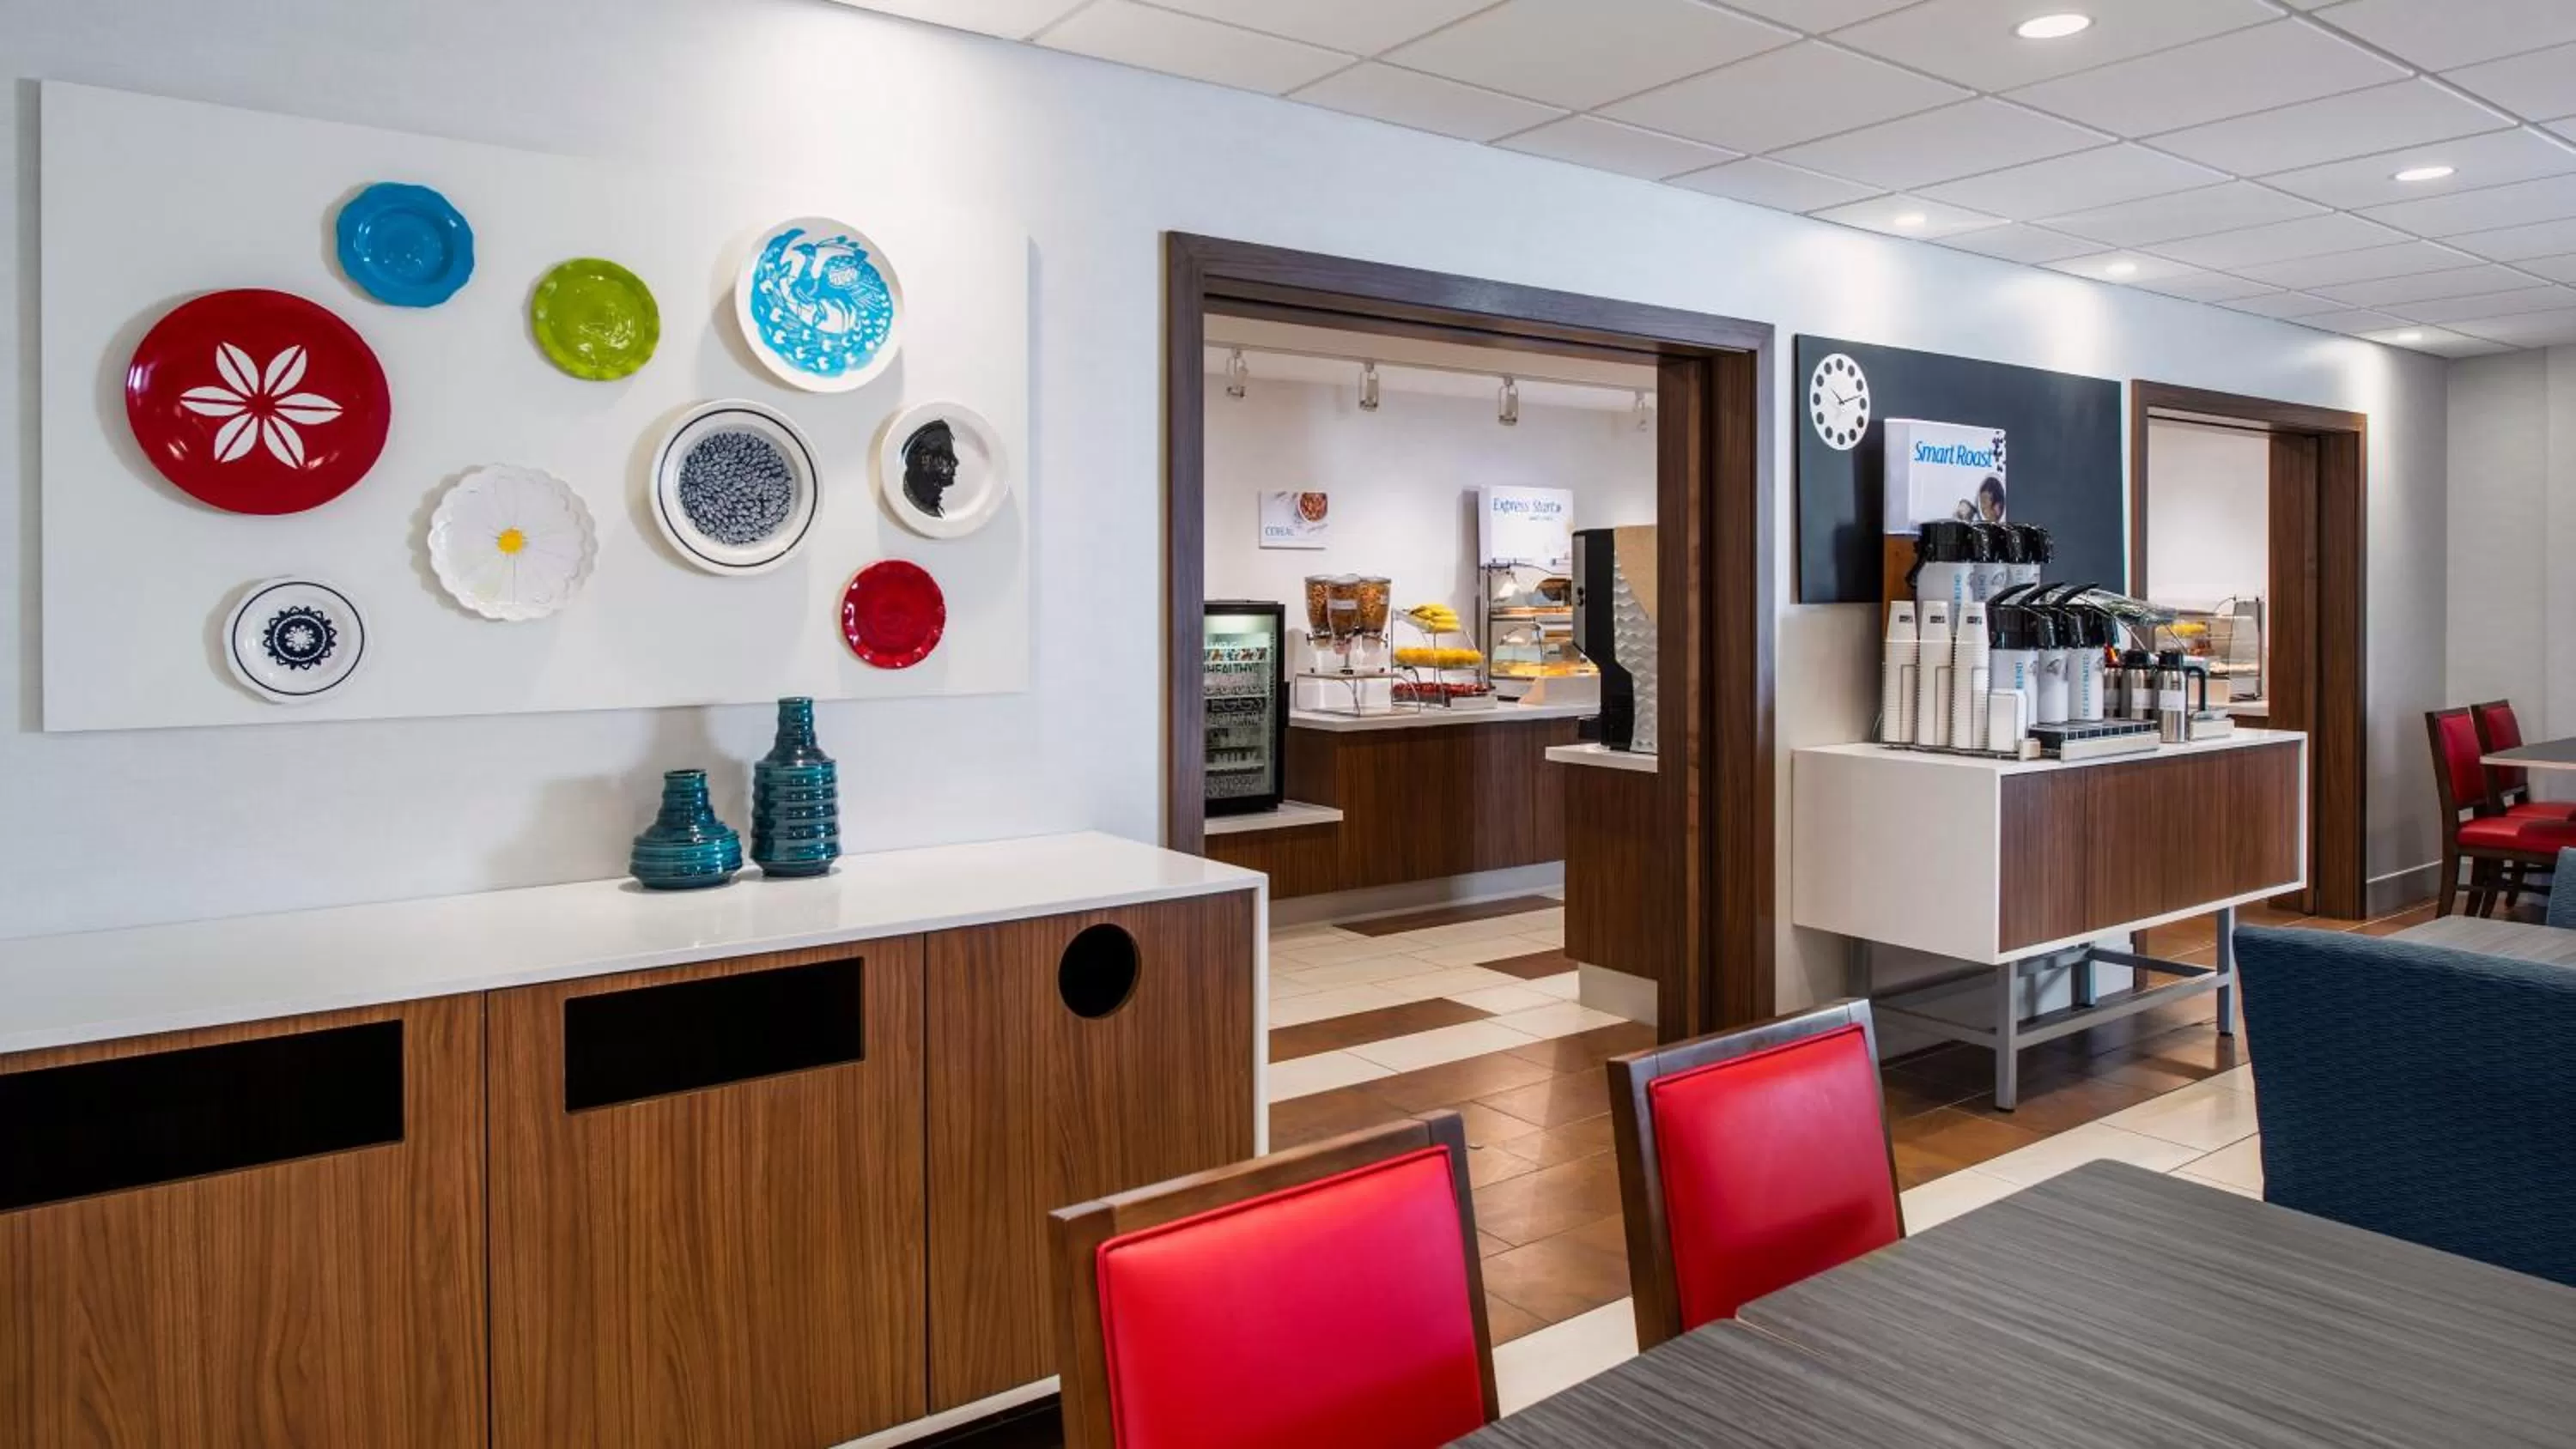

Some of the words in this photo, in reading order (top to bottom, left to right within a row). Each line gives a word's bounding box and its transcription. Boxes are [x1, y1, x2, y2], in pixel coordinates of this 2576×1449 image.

[1914, 440, 1955, 464] Smart
[1956, 445, 1992, 467] Roast
[1493, 497, 1528, 514] Express
[1533, 500, 1555, 513] Start
[1265, 525, 1296, 537] CEREAL
[1953, 573, 1962, 600] BLEND
[2014, 662, 2024, 689] BLEND
